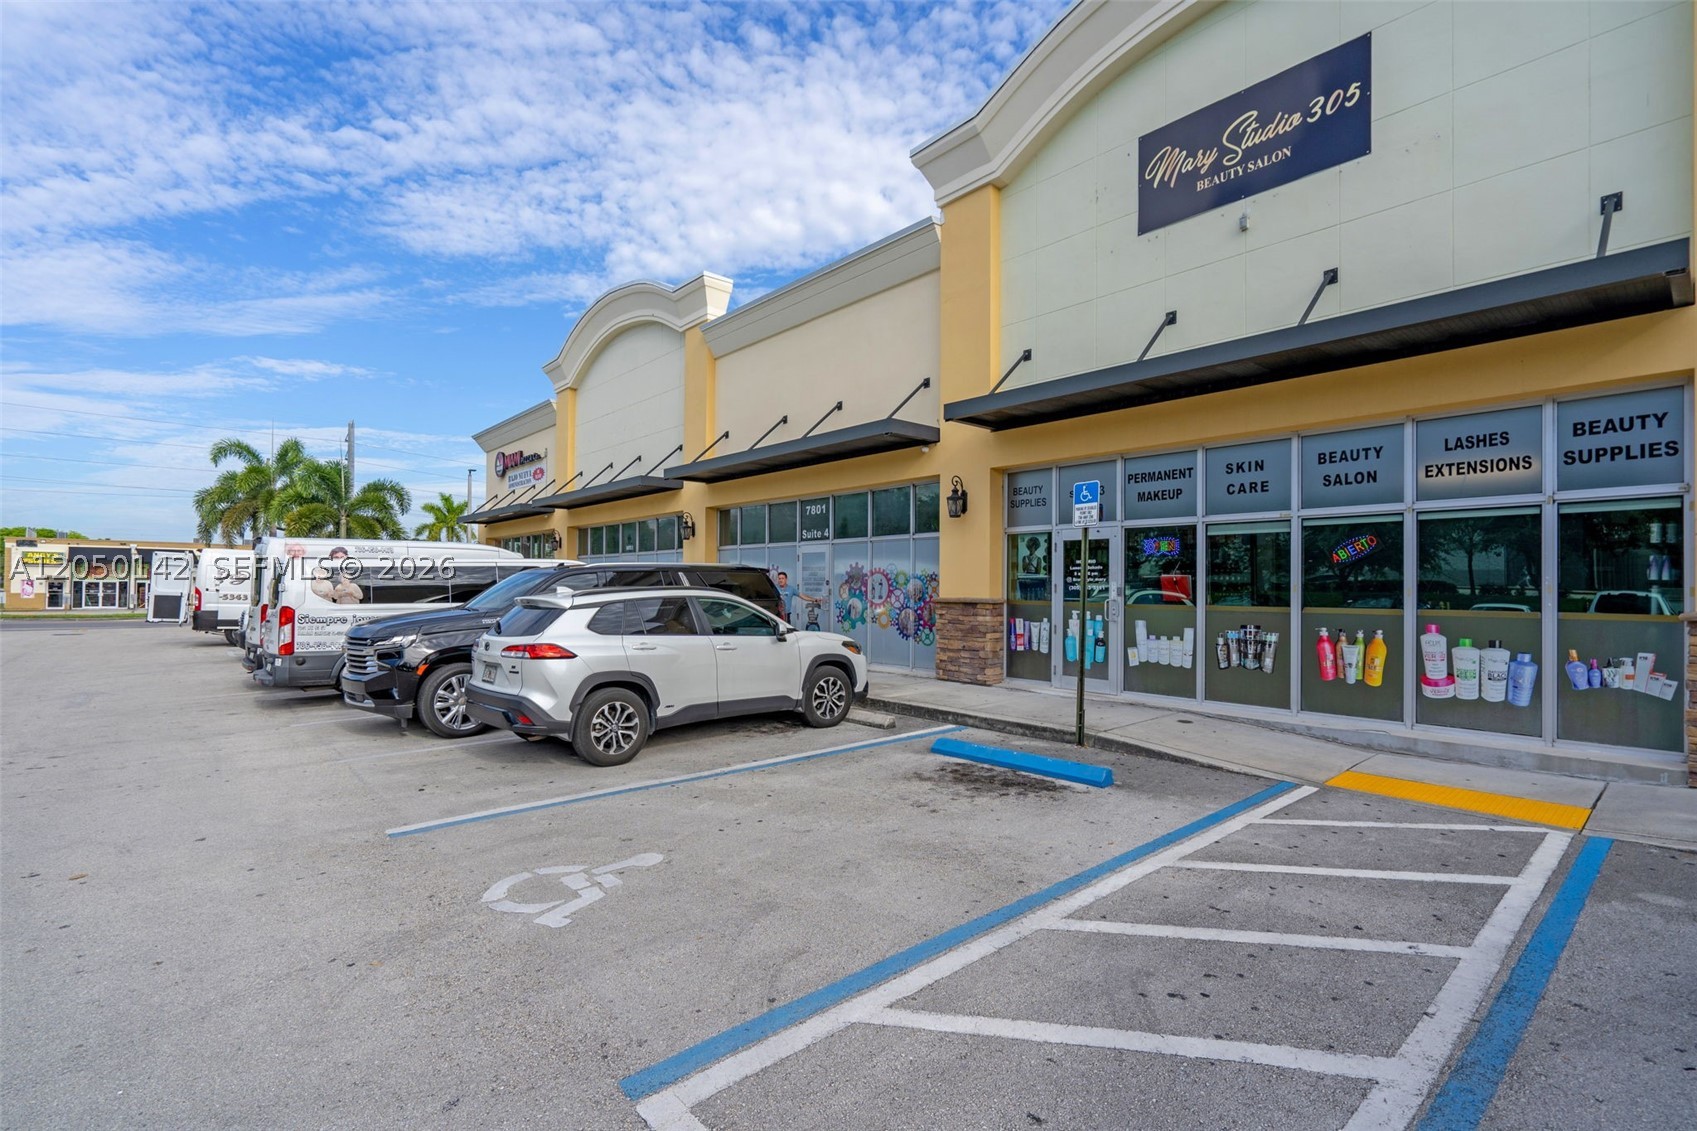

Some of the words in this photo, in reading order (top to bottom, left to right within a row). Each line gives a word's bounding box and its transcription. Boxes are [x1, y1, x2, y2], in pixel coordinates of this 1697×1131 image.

[1145, 145, 1219, 189] Mary
[1222, 110, 1303, 166] Studio
[1306, 82, 1361, 123] 305
[1196, 164, 1245, 192] BEAUTY
[1247, 146, 1292, 172] SALON
[1572, 412, 1669, 437] BEAUTY
[1444, 431, 1510, 452] LASHES
[1318, 446, 1384, 465] BEAUTY
[1562, 440, 1680, 466] SUPPLIES
[1225, 460, 1265, 475] SKIN
[1424, 455, 1533, 478] EXTENSIONS
[1128, 467, 1194, 484] PERMANENT
[1322, 470, 1378, 487] SALON
[1012, 485, 1044, 496] BEAUTY
[1137, 488, 1183, 502] MAKEUP
[1226, 480, 1270, 496] CARE
[806, 504, 826, 516] 7801
[1010, 498, 1047, 508] SUPPLIES
[802, 530, 822, 539] Suite
[824, 529, 830, 538] 4
[1332, 535, 1377, 563] ABIERTO
[298, 614, 348, 626] Siempre
